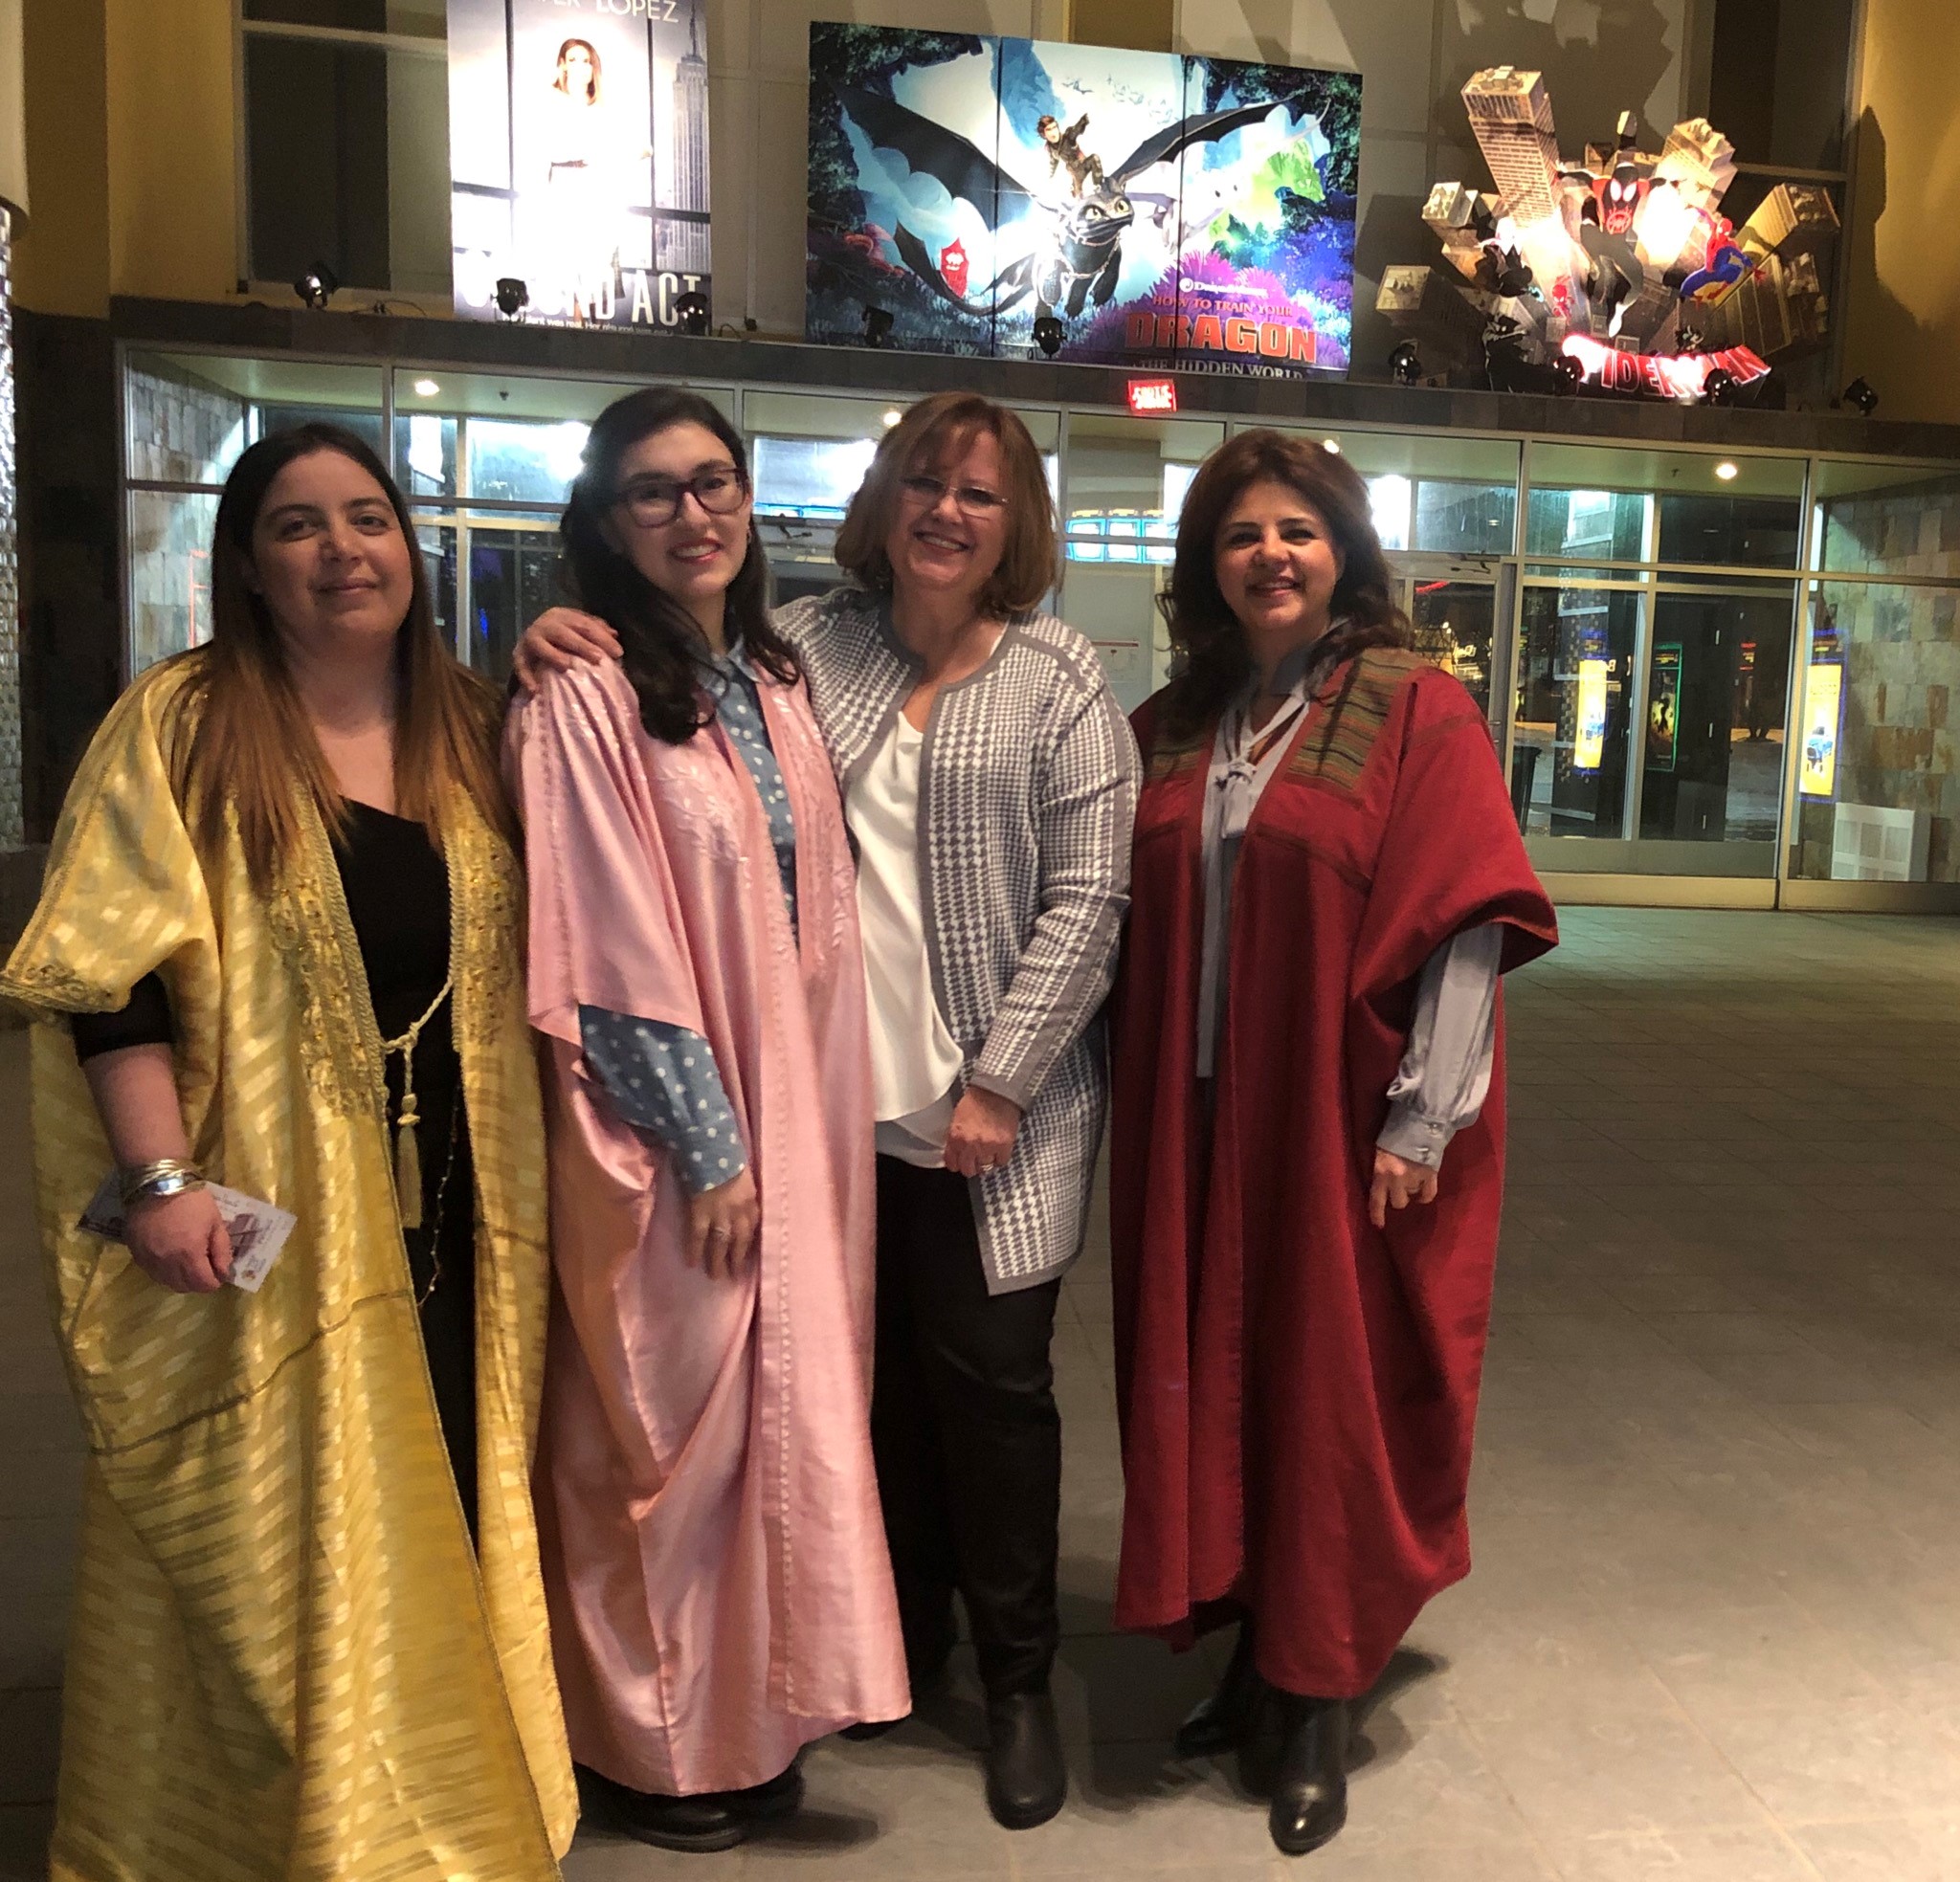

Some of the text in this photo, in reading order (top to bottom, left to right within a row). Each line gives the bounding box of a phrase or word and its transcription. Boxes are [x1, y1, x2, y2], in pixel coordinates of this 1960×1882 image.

[596, 0, 679, 23] LOPEZ
[1152, 297, 1293, 318] HOW TO TRAIN YOUR
[1125, 312, 1317, 364] DRAGON
[1140, 360, 1303, 379] THE HIDDEN WORLD
